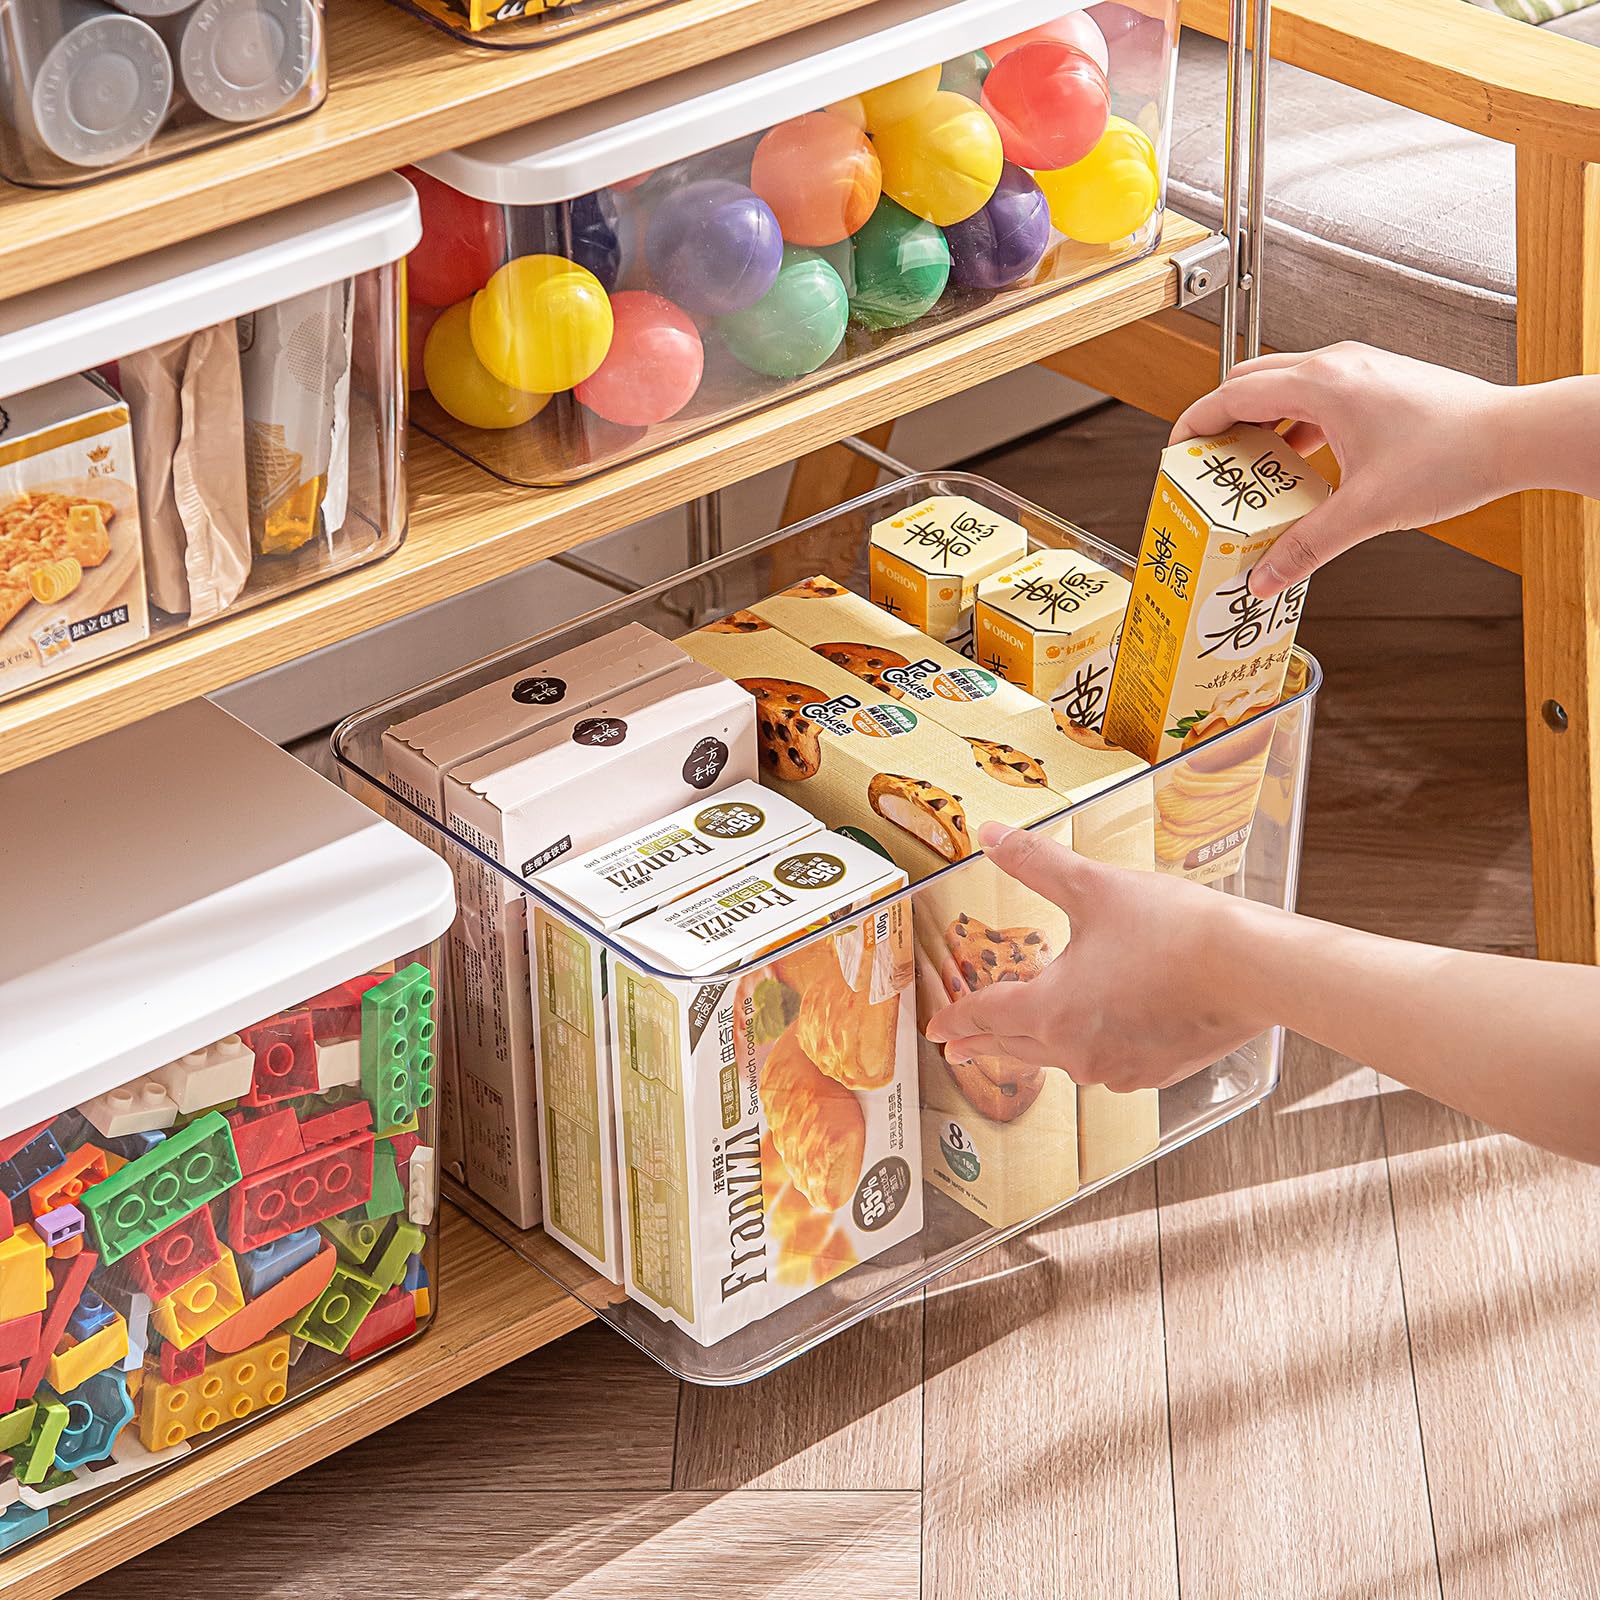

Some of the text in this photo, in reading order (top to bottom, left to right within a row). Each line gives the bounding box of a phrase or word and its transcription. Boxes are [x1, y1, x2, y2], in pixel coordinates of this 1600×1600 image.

[1170, 501, 1199, 539] ORION
[886, 569, 918, 593] ORION
[992, 625, 1025, 650] ORION
[882, 669, 935, 699] Cookies
[905, 659, 941, 680] Pie
[801, 704, 854, 734] Cookies
[824, 695, 861, 716] Pie
[718, 813, 760, 836] 35%
[584, 823, 680, 870] Sandwich cookie pie
[604, 836, 715, 888] Franzzi
[797, 865, 842, 887] 35%
[664, 875, 760, 923] Sandwich cookie pie
[684, 887, 798, 940] Franzzi
[876, 912, 889, 940] 100g
[693, 984, 711, 1013] NEW
[719, 1004, 736, 1064] 曲奇派
[744, 996, 760, 1116] Sandwich cookie pie
[712, 1153, 725, 1194] 法丽兹
[721, 1122, 767, 1304] Franzzi
[861, 1176, 886, 1227] 35%
